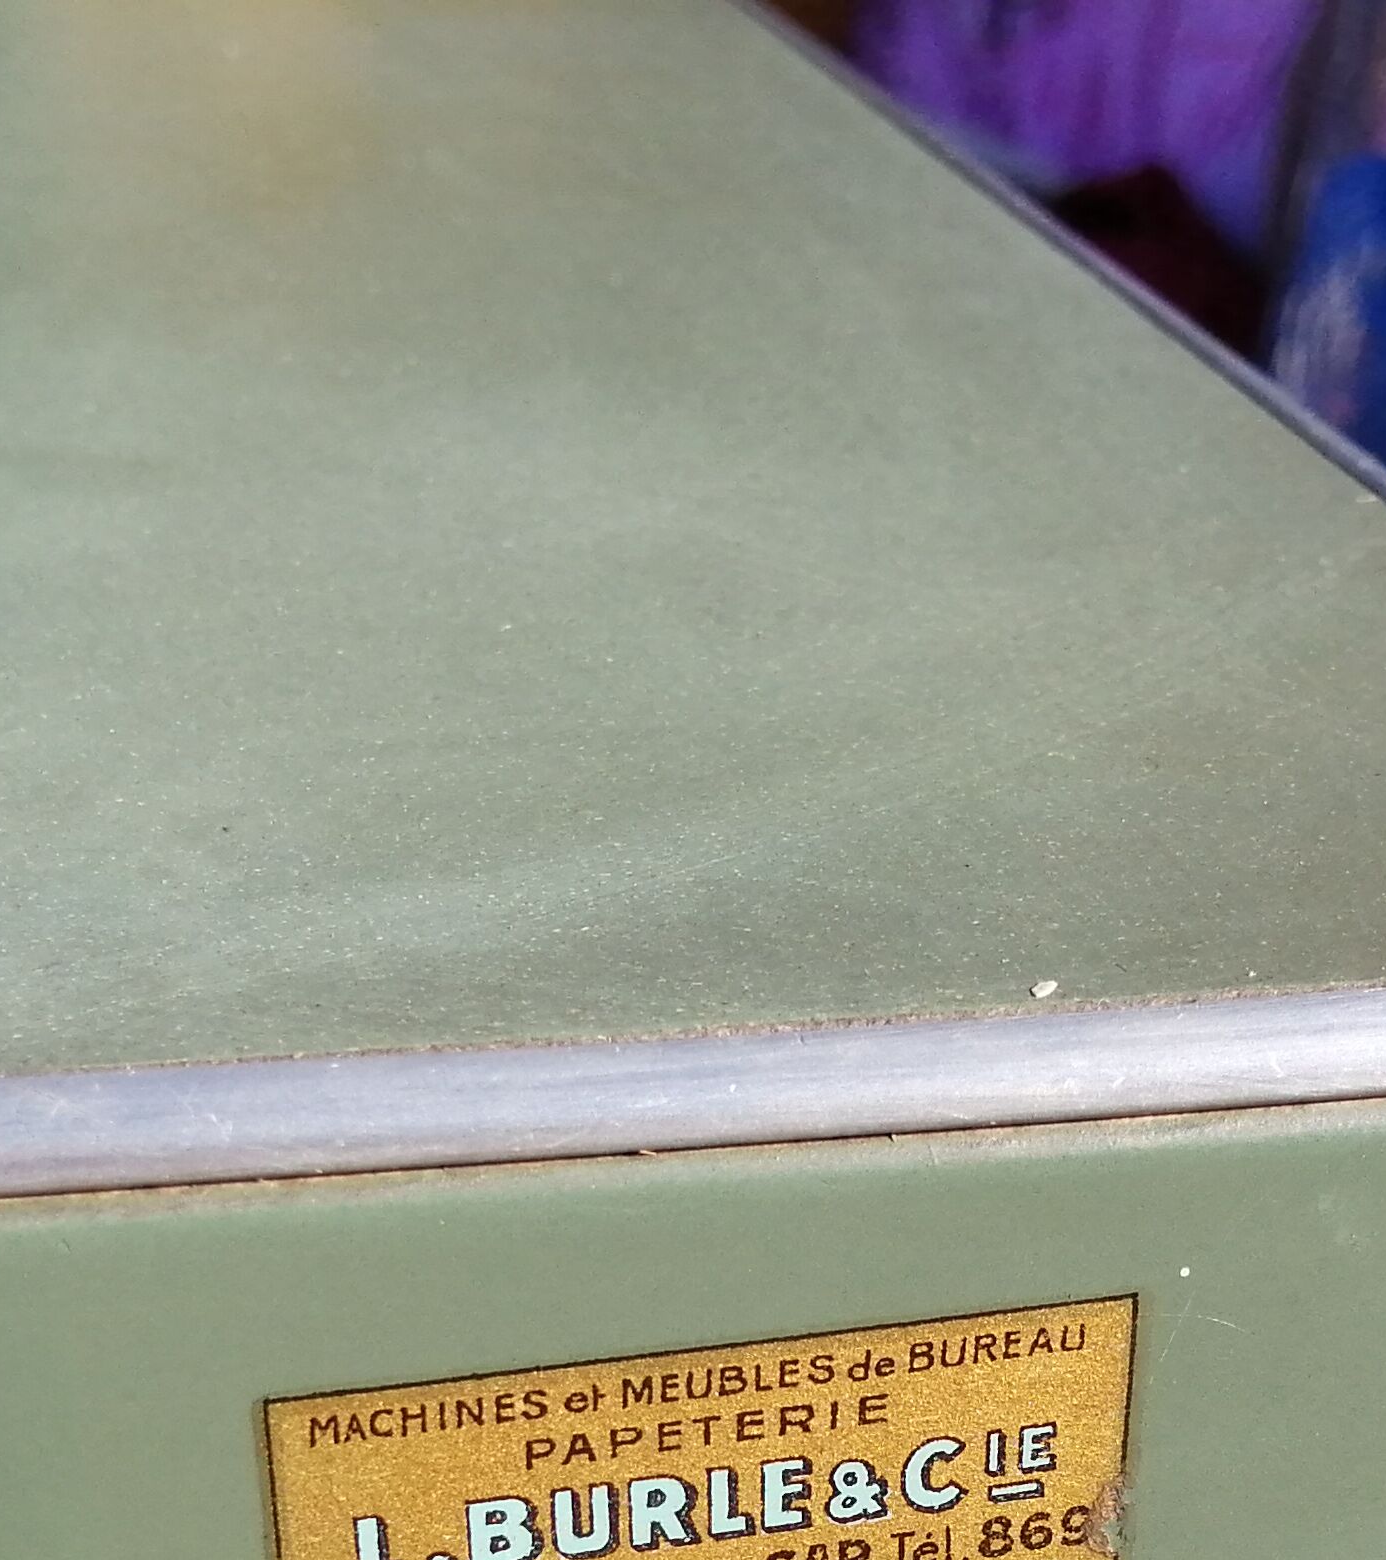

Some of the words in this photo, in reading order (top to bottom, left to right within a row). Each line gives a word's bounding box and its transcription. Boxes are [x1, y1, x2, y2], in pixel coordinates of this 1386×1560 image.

[308, 1389, 548, 1448] MACHINES
[564, 1386, 609, 1412] et
[620, 1354, 835, 1410] MEUBLES
[846, 1349, 897, 1382] de
[906, 1323, 1088, 1374] BUREAU
[523, 1394, 890, 1470] PAPETERIE
